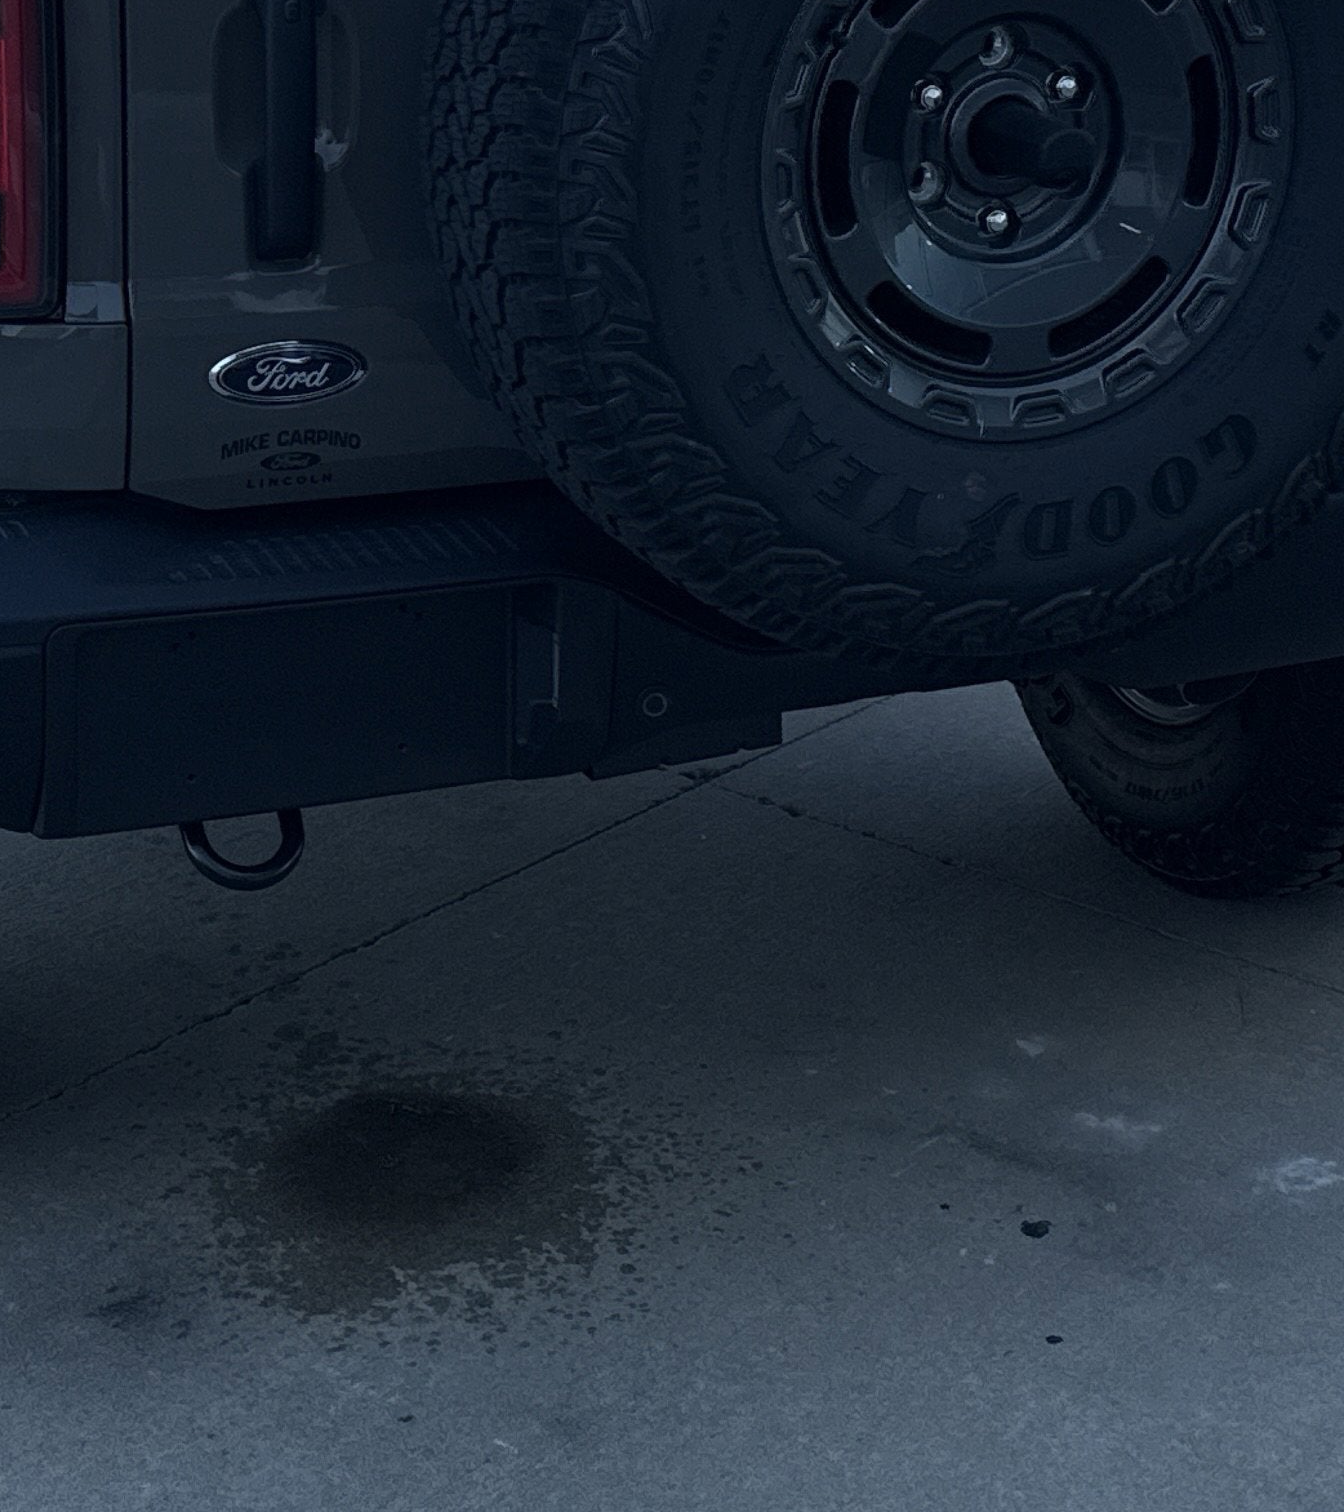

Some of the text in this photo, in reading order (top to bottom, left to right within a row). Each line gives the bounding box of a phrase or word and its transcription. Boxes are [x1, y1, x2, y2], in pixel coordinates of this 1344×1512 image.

[246, 356, 332, 392] Ford
[220, 428, 362, 460] MIKE CARPINO
[269, 452, 312, 470] Ford
[246, 473, 333, 490] LINCOLN
